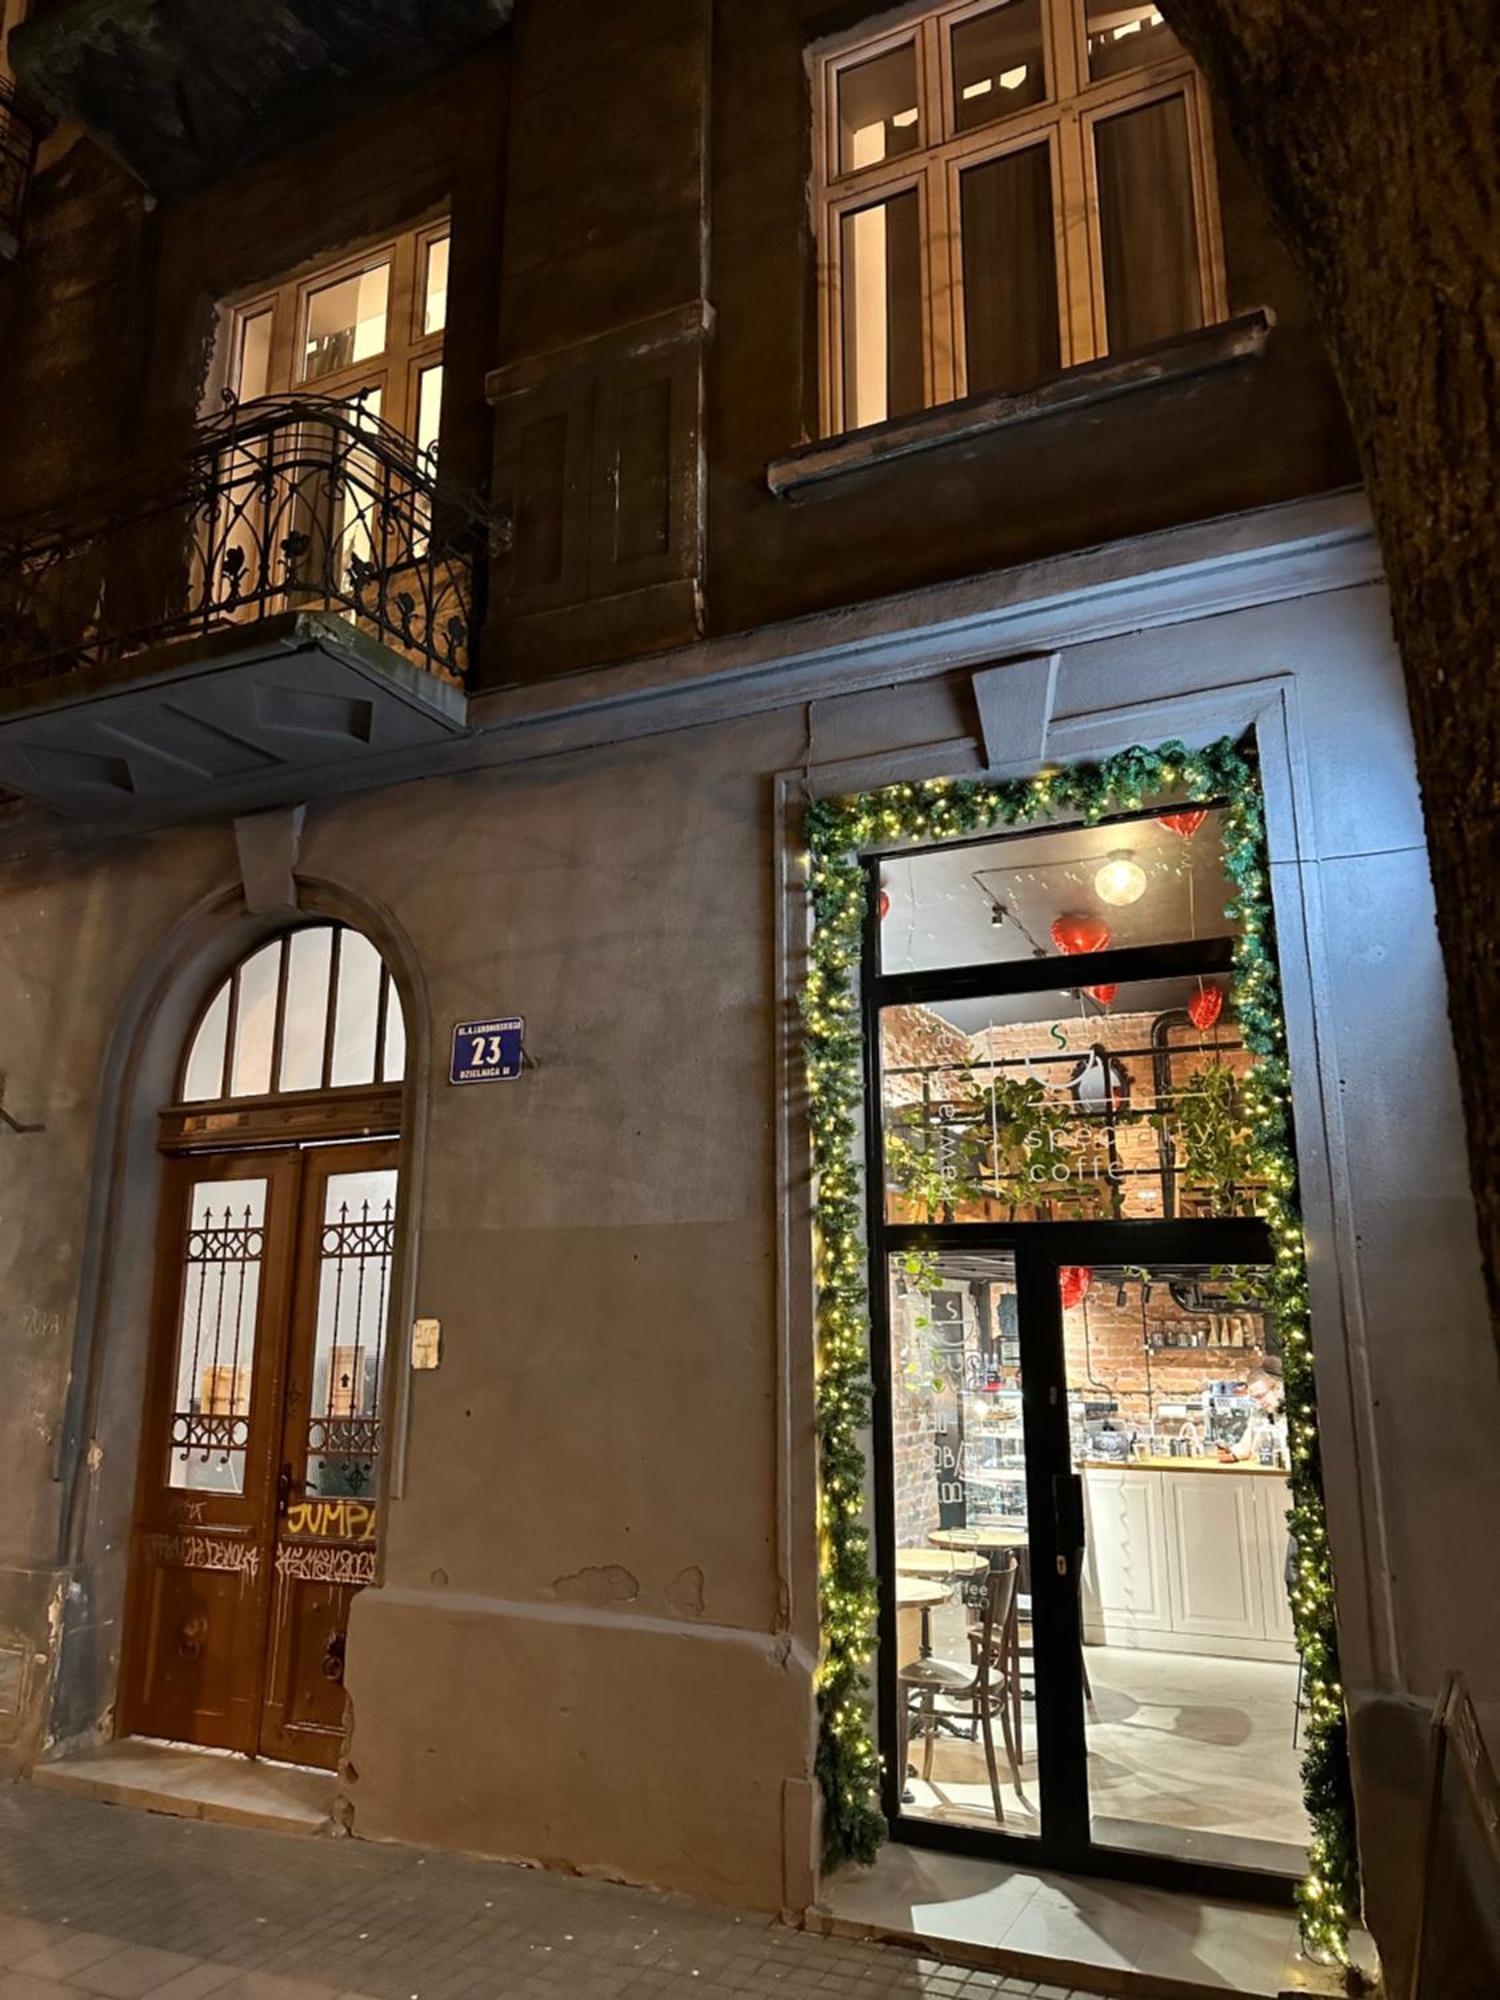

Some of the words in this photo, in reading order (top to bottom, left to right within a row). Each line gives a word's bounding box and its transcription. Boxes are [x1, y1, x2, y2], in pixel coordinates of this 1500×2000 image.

[471, 1036, 502, 1065] 23
[938, 1030, 958, 1201] kawiarnia
[1027, 1117, 1214, 1152] specialty
[1029, 1154, 1154, 1183] coffee
